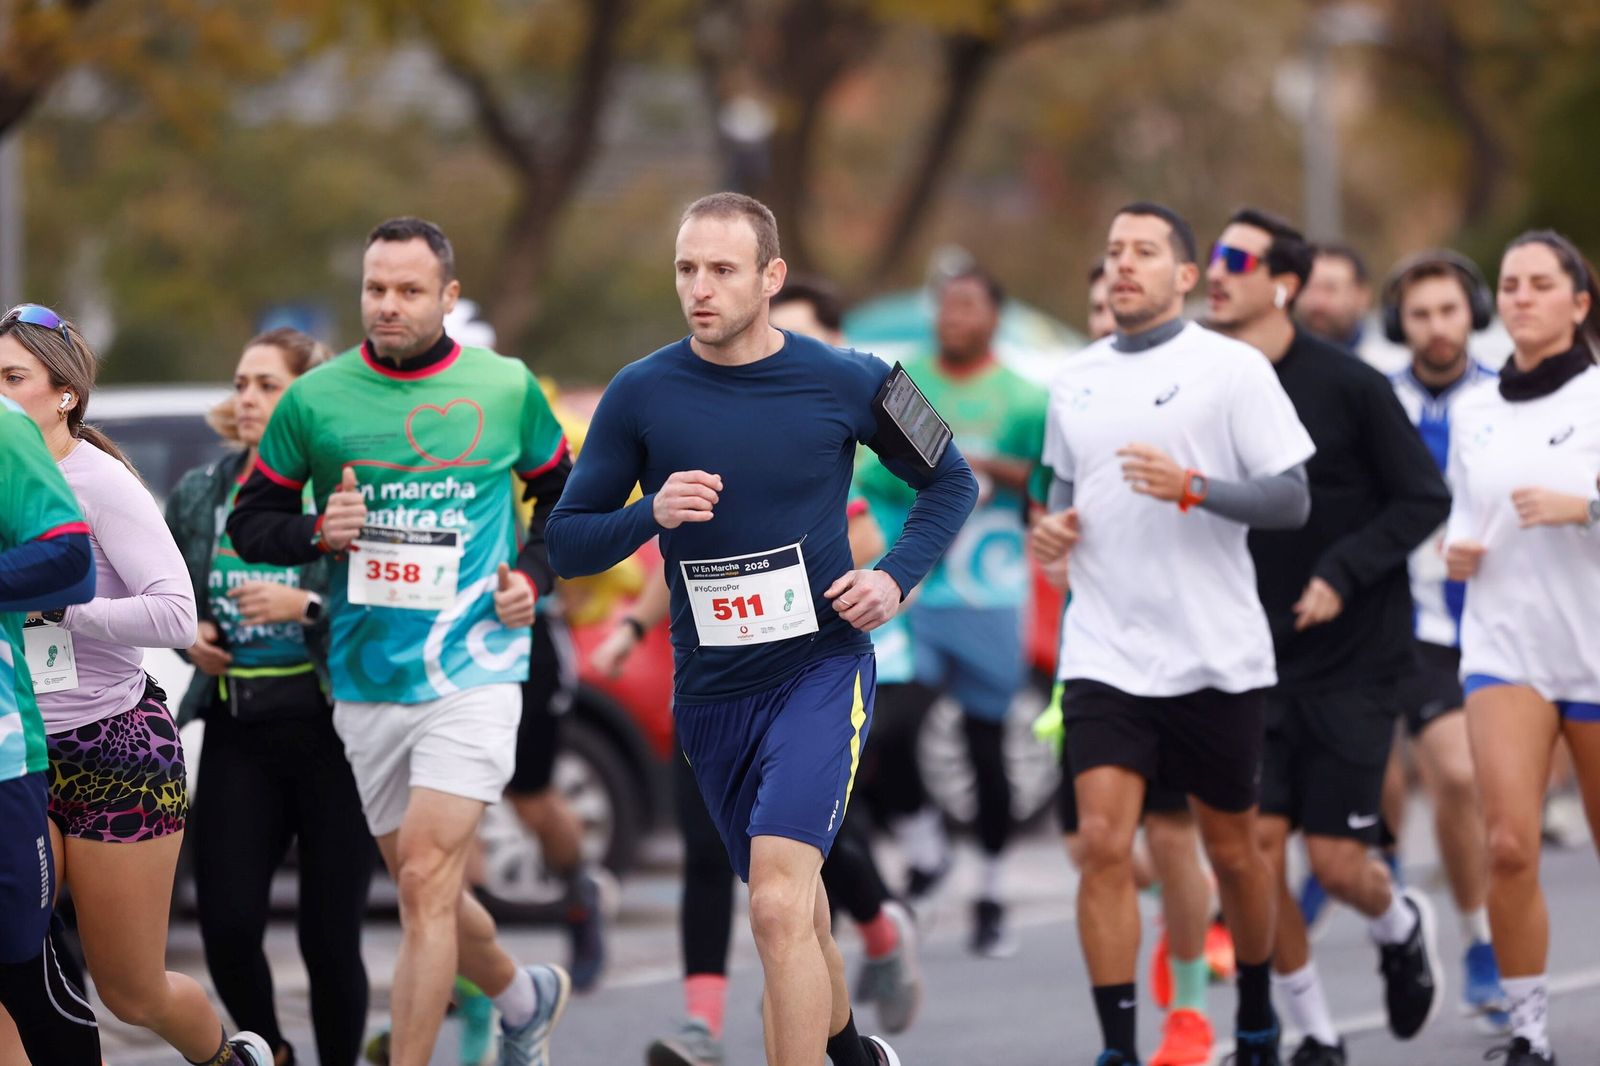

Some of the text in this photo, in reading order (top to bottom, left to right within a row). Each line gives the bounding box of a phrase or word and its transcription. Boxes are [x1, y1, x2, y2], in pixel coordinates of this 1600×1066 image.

[381, 476, 477, 501] marcha
[365, 504, 438, 529] ontra
[365, 559, 421, 583] 358
[701, 565, 711, 573] En
[711, 563, 740, 573] Marcha
[744, 559, 770, 571] 2026
[208, 569, 224, 589] n
[694, 584, 740, 592] #YoCorroPor
[712, 594, 764, 621] 511
